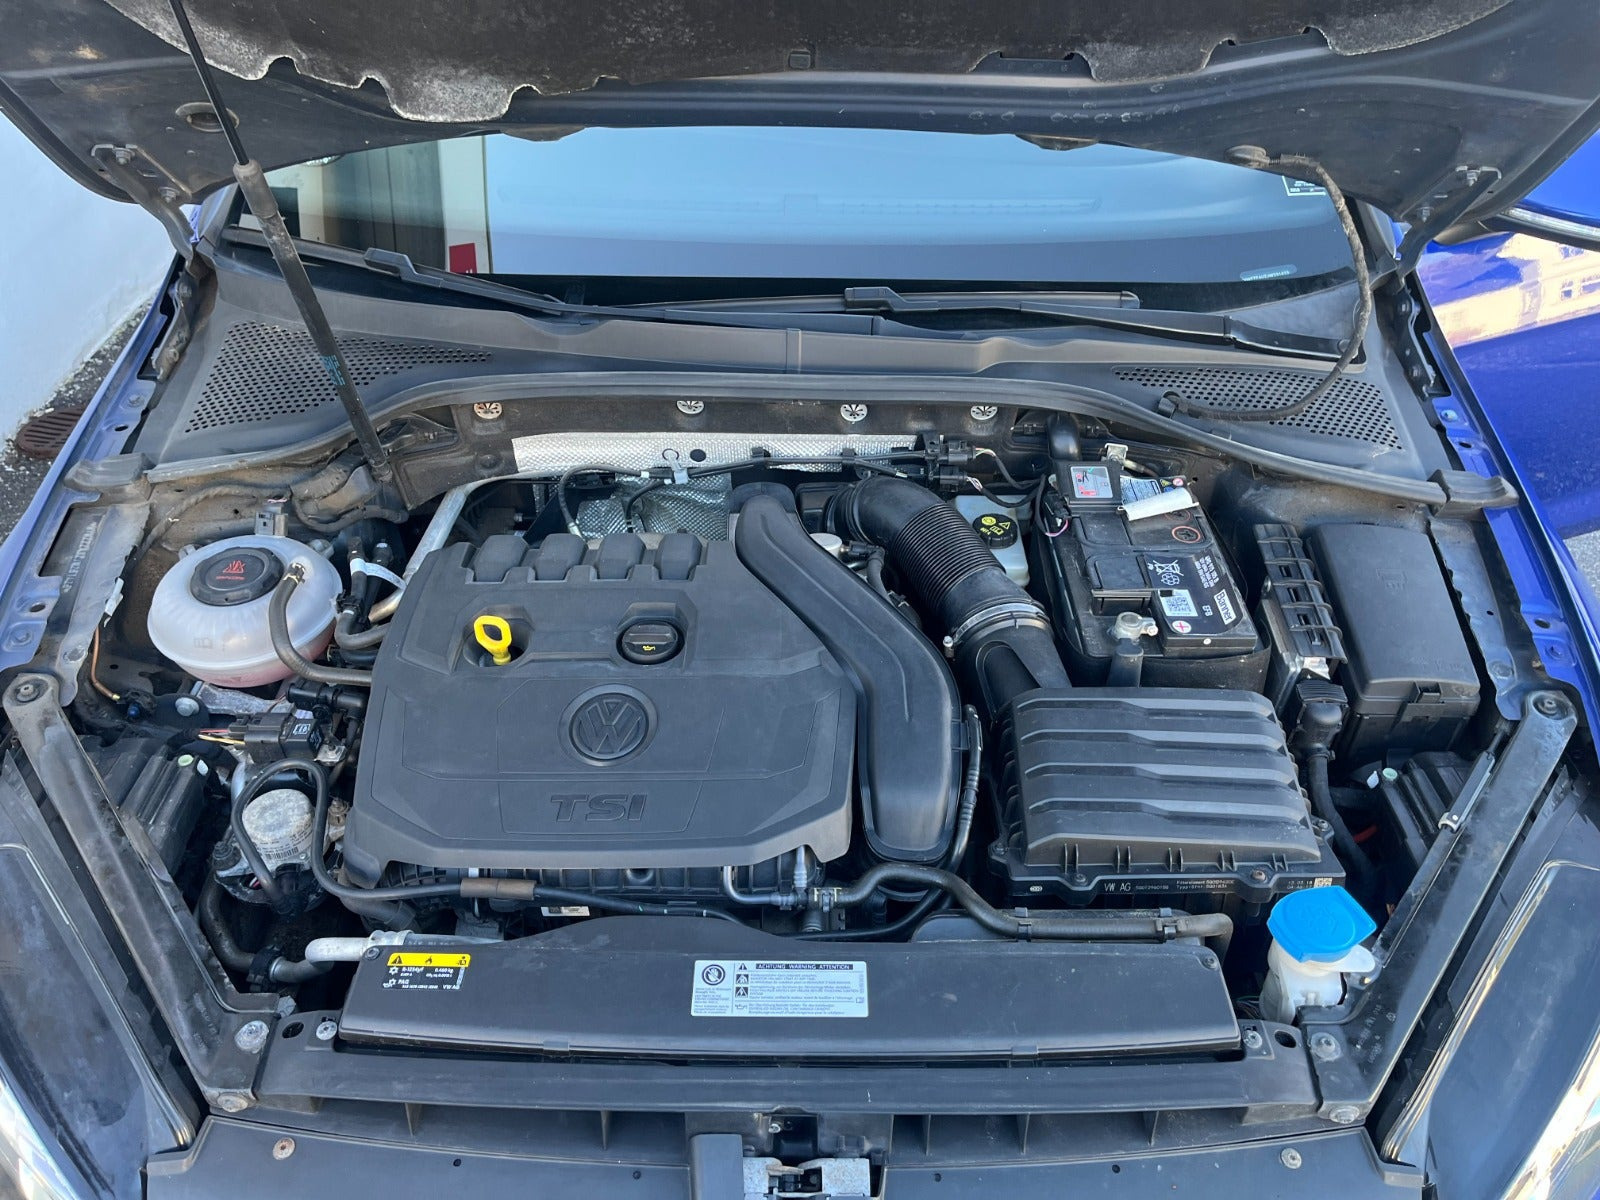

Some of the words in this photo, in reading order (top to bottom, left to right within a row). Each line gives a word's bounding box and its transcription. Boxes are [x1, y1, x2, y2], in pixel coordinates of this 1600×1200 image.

[1201, 605, 1213, 617] EFB
[1215, 592, 1234, 622] Banner
[550, 794, 648, 822] TSI
[1104, 882, 1115, 892] VW
[1119, 882, 1132, 892] AG
